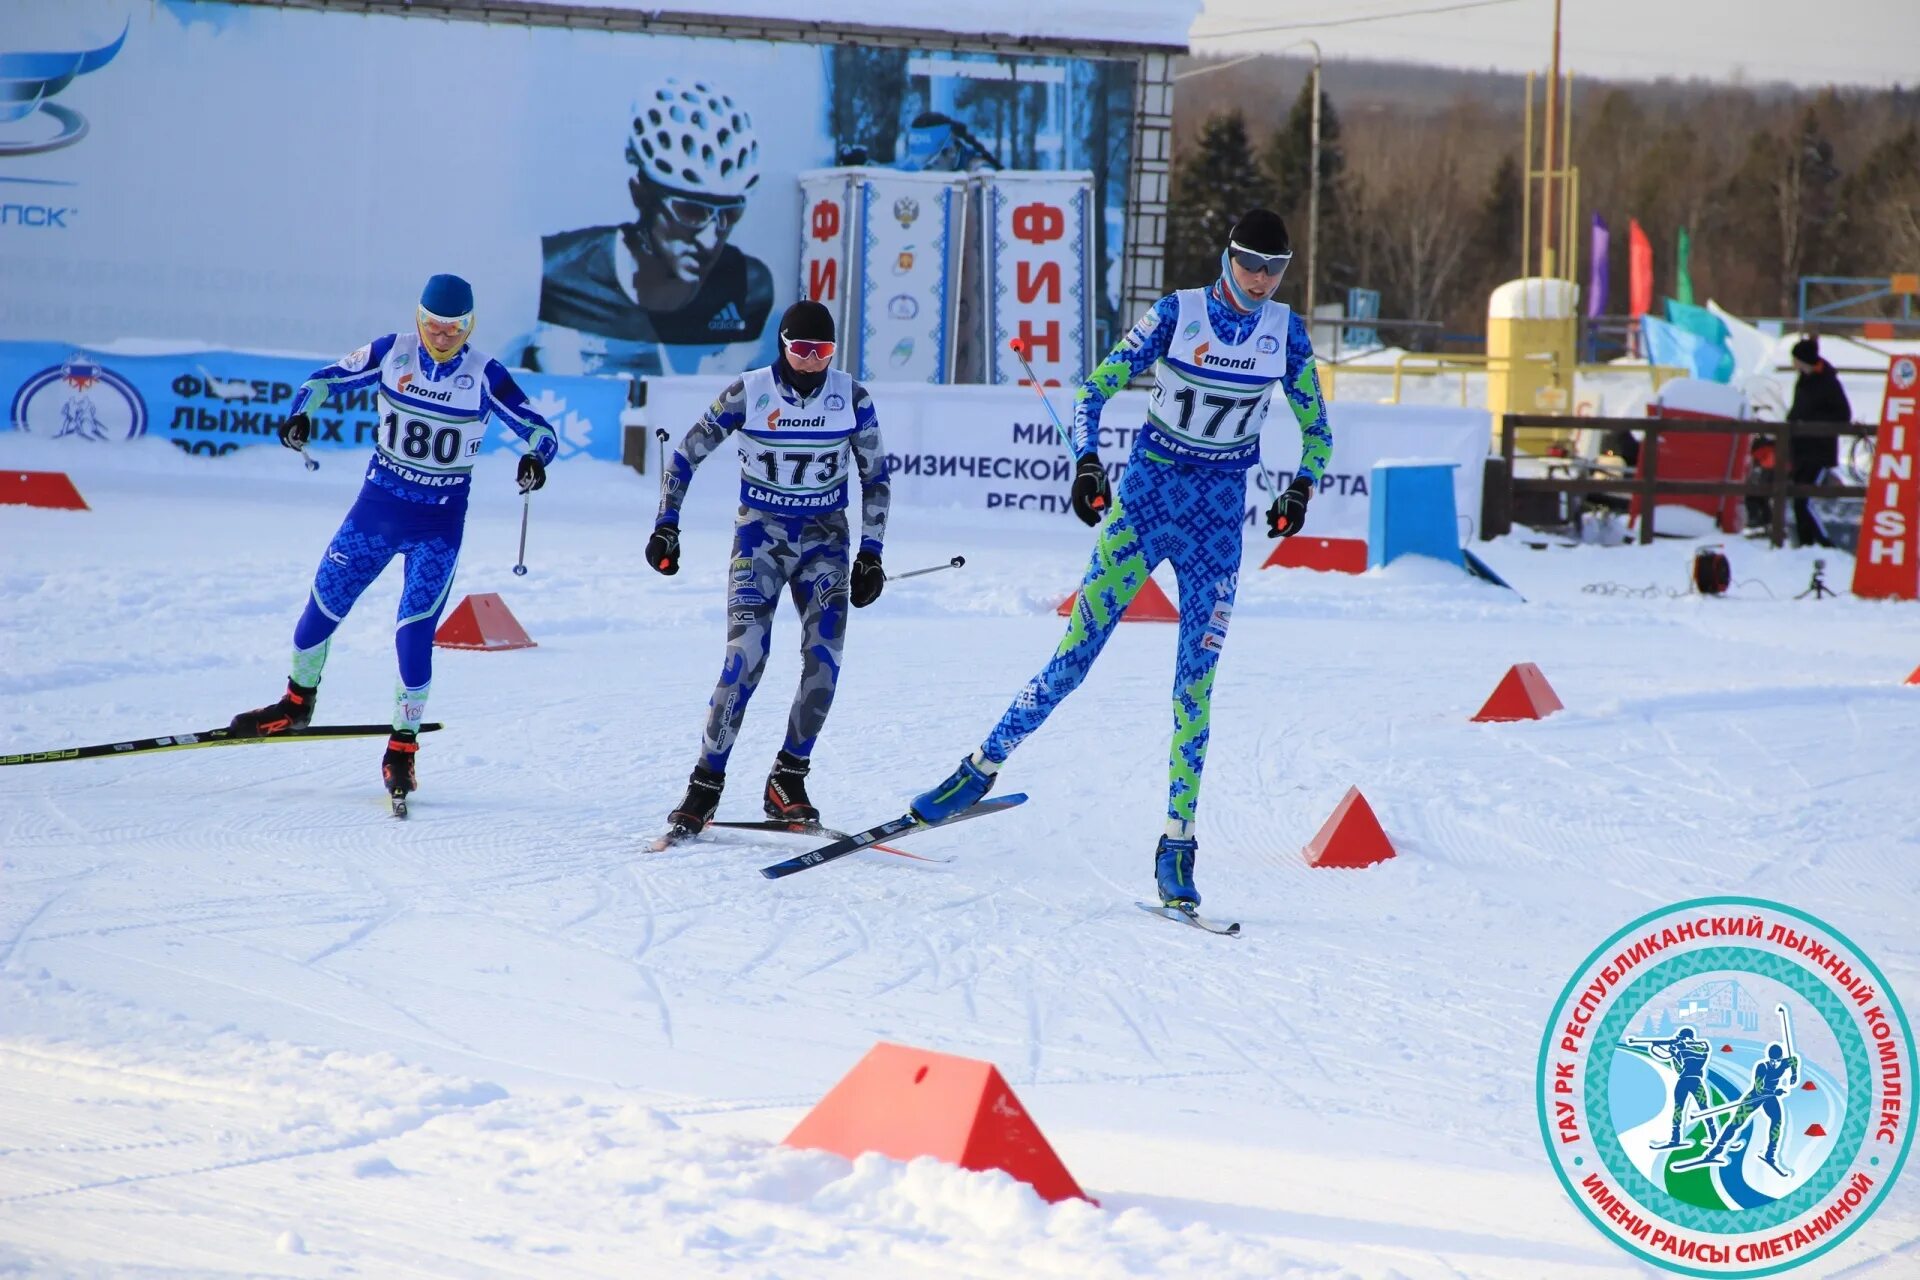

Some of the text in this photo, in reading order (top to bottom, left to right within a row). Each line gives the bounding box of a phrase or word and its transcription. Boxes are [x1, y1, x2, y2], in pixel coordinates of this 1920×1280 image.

[1012, 202, 1065, 387] ФИН
[1204, 354, 1257, 370] mondi
[172, 374, 379, 414] ФДЕРЦИ
[405, 383, 453, 402] mondi
[170, 406, 344, 443] ЛЫЖНХ
[777, 416, 826, 427] mondi
[1174, 386, 1263, 438] 177
[384, 410, 462, 465] 180
[1013, 423, 1140, 448] МИНСТ
[756, 449, 840, 485] 173
[885, 453, 1070, 482] ФИЗИЧЕСКОЙ
[1256, 469, 1369, 496] СПРТА
[1869, 396, 1917, 566] FINISH
[747, 486, 841, 507] СЫКТЫВКАР
[986, 492, 1073, 514] РЕСПУ
